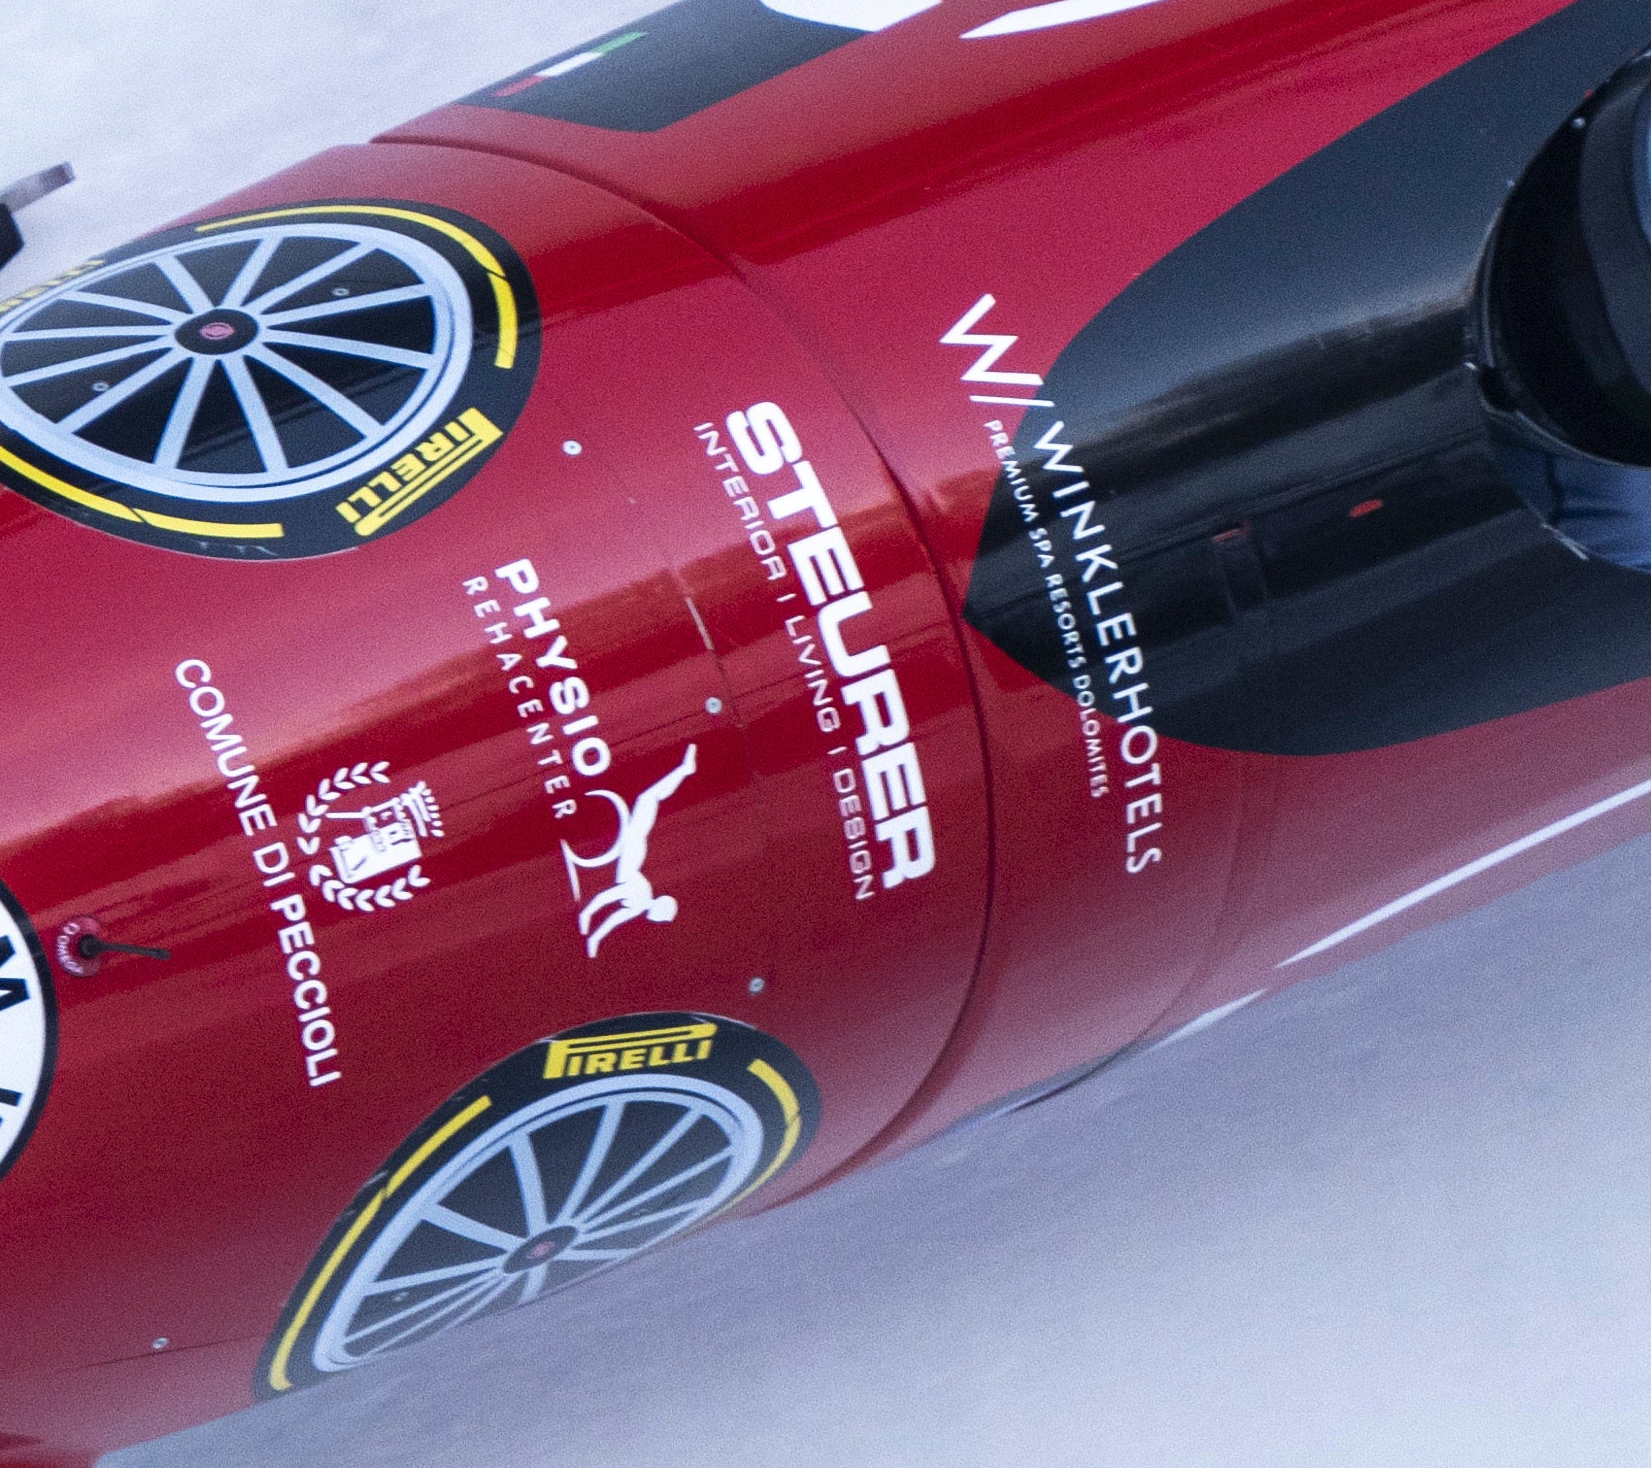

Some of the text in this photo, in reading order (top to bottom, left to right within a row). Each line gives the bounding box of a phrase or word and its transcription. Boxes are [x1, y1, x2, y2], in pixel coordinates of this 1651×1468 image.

[334, 406, 505, 537] PIRELLI
[692, 421, 788, 581] INTERIOR
[784, 614, 842, 734] LIVING
[832, 767, 877, 901] DESIGN
[724, 400, 937, 890] STEURER
[982, 418, 1110, 800] PREMIUM SPA RESORTS DOLOMITES
[1033, 419, 1163, 875] WINKLERHOTELS
[461, 575, 578, 820] REHACENTER
[493, 557, 613, 777] PHYSIO
[173, 658, 343, 1088] COMUNE DI PECCIOLI
[542, 1022, 719, 1081] PIRELLI
